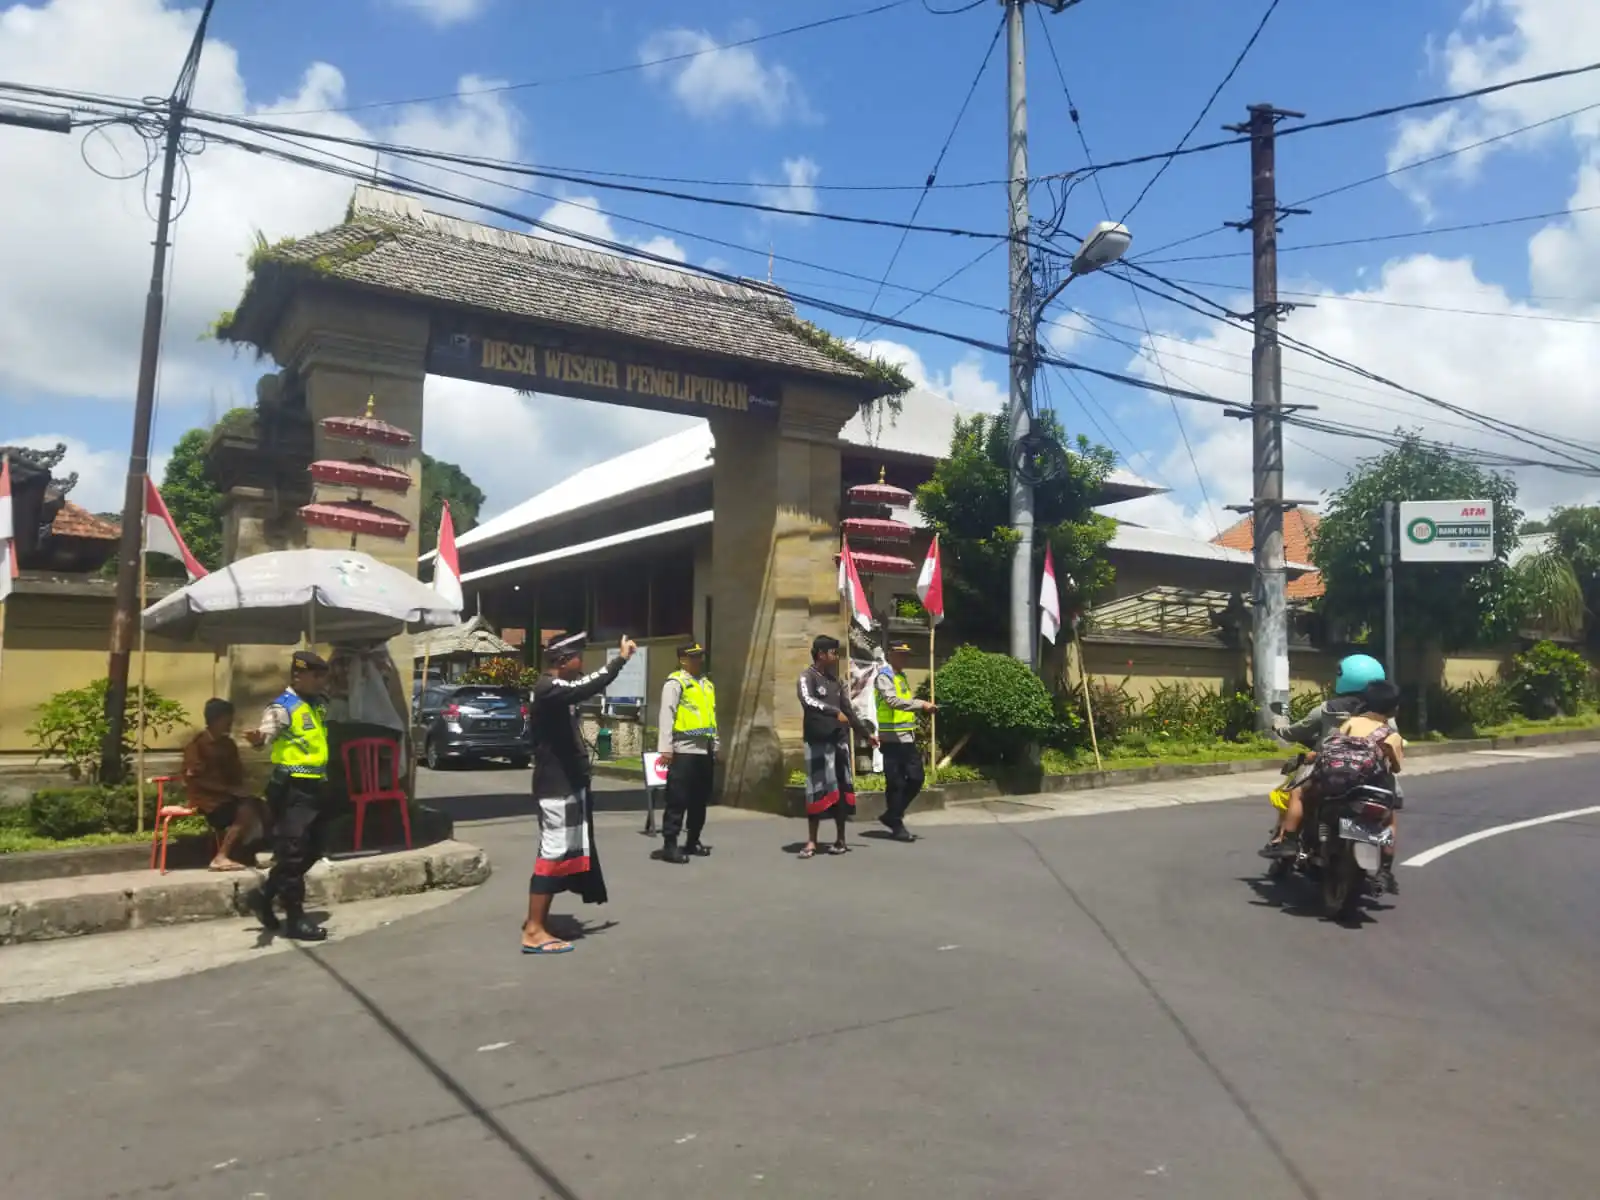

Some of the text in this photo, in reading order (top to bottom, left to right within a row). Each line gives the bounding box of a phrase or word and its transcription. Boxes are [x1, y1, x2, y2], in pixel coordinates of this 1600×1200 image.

[481, 340, 749, 411] DESA WISATA PENGLIPURAN
[1460, 507, 1487, 517] ATM
[1438, 527, 1458, 535] BANK
[1473, 527, 1489, 535] BALI
